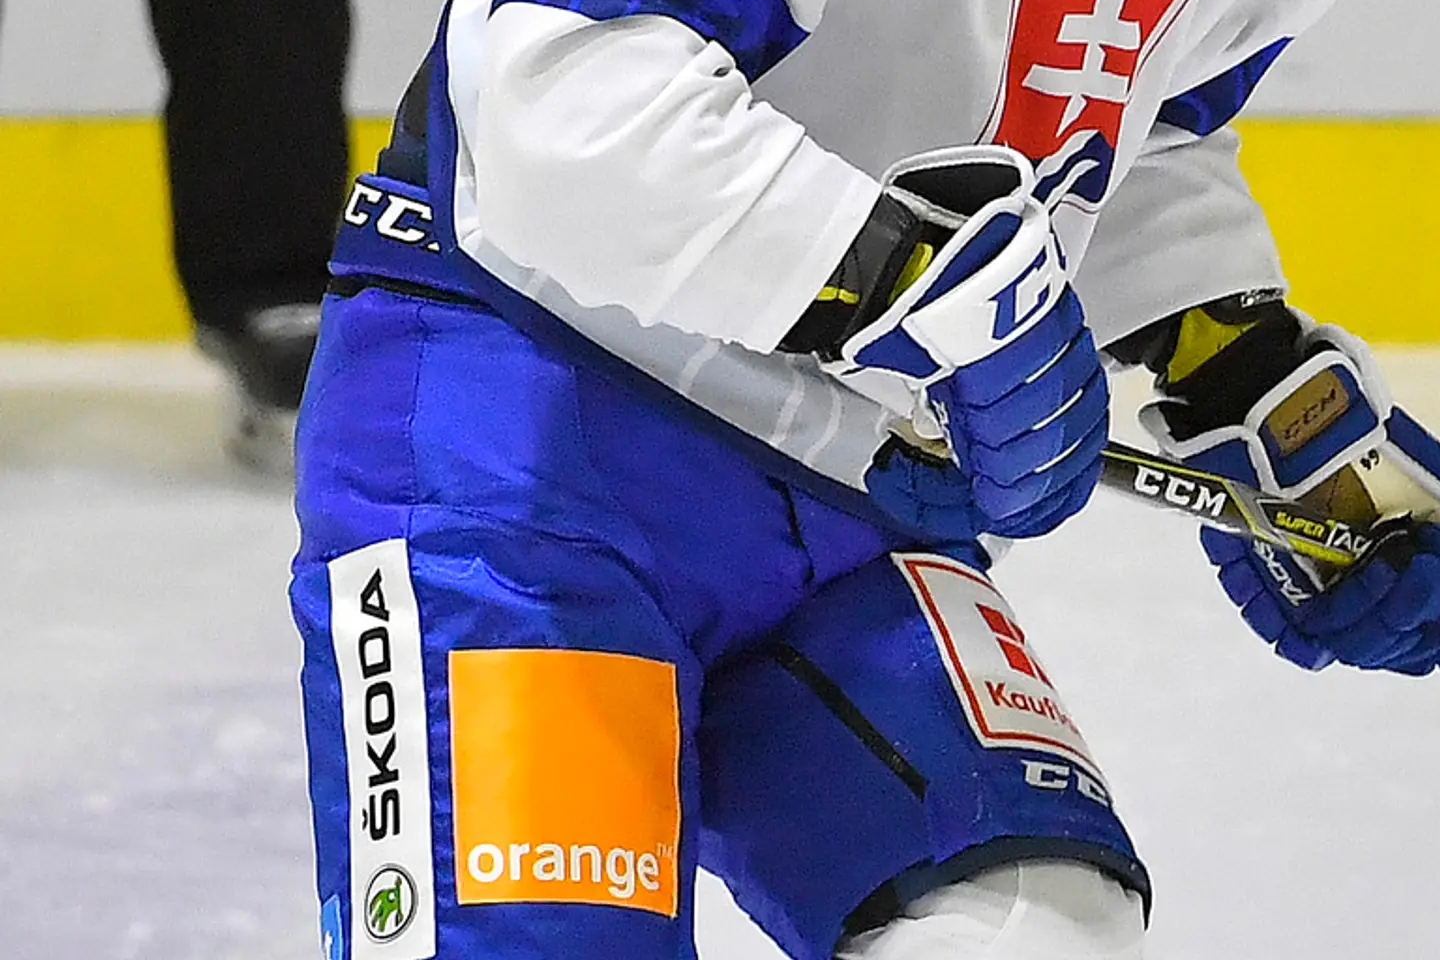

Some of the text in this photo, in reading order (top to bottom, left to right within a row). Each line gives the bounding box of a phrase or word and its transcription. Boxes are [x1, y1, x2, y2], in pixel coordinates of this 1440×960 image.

[345, 183, 441, 251] CC
[1281, 387, 1339, 441] CCM
[1133, 466, 1228, 518] CCM
[1275, 511, 1373, 560] SUPER TAC
[358, 568, 401, 842] ŠKODA
[468, 842, 660, 898] orange
